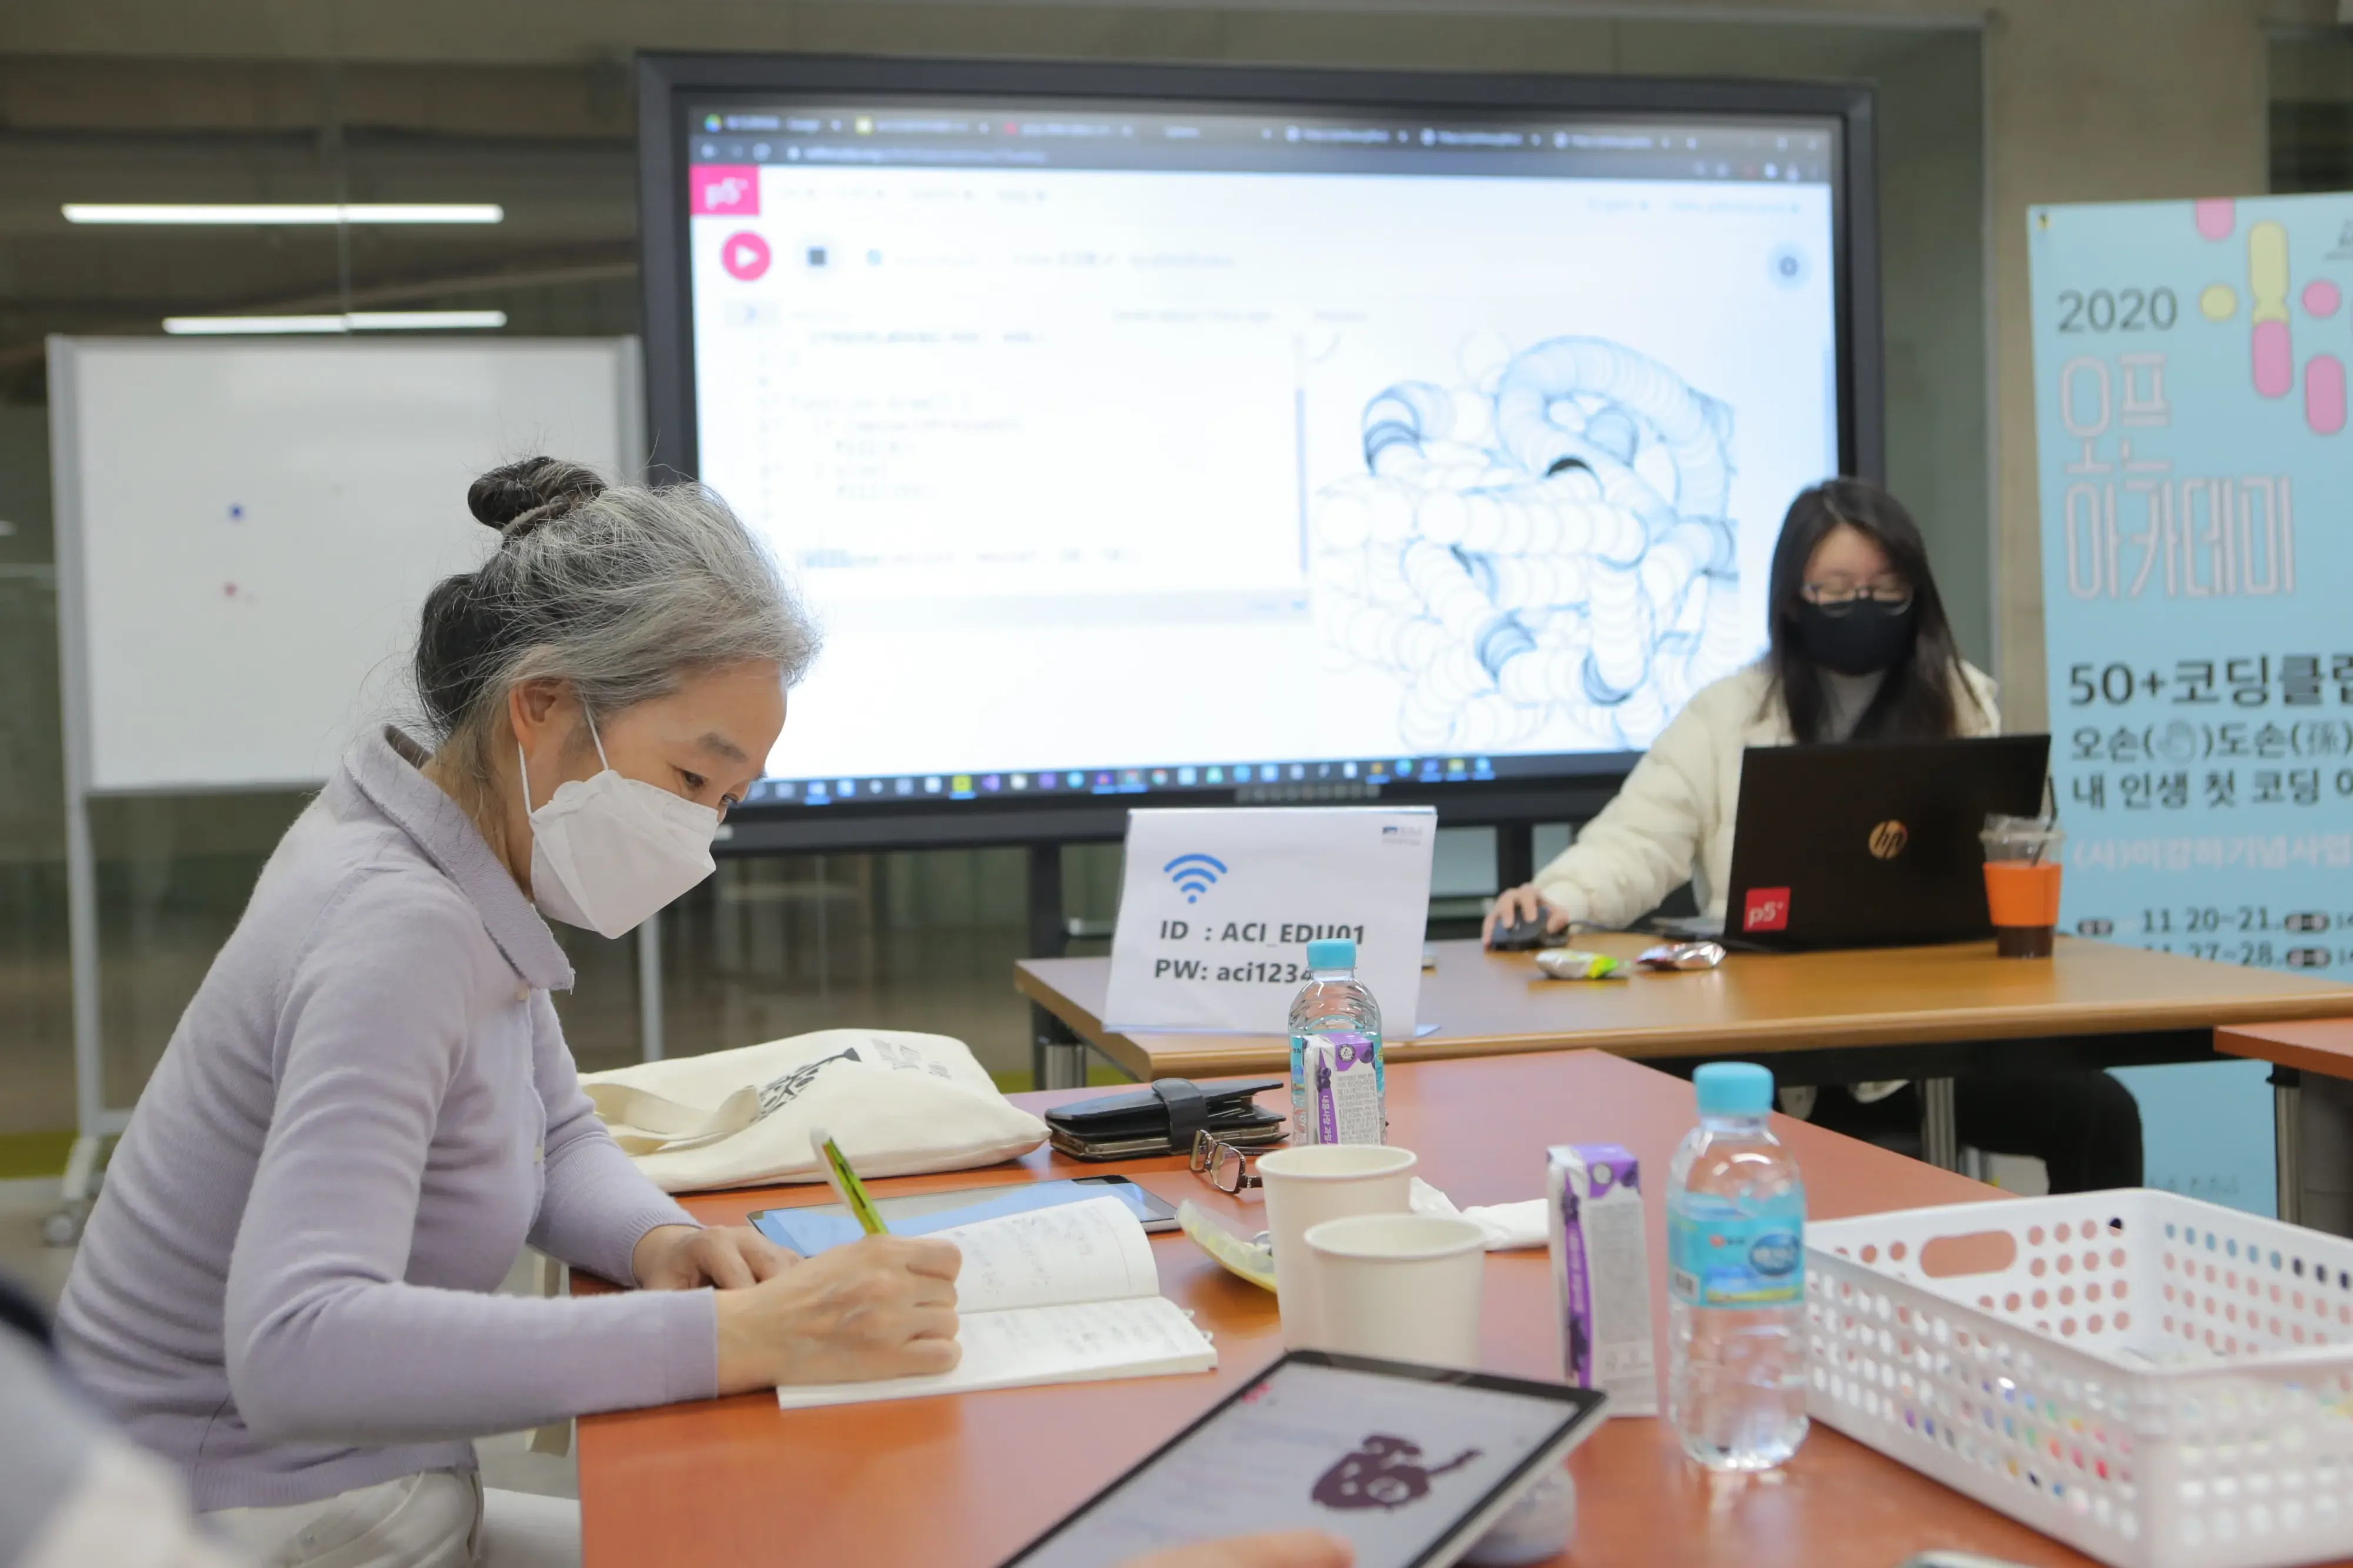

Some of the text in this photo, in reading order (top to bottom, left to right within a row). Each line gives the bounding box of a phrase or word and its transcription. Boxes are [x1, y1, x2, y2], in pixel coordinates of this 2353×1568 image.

[2058, 288, 2178, 333] 2020
[2061, 353, 2172, 474] 오픈
[2064, 476, 2295, 599] 아카데미
[2072, 772, 2105, 809] 내
[2119, 770, 2187, 810] 인생
[2205, 768, 2235, 808] 첫
[2252, 767, 2319, 807] 코딩
[1161, 920, 1189, 940] ID
[1221, 923, 1364, 948] ACI_EDU01
[1155, 959, 1208, 980] PW:
